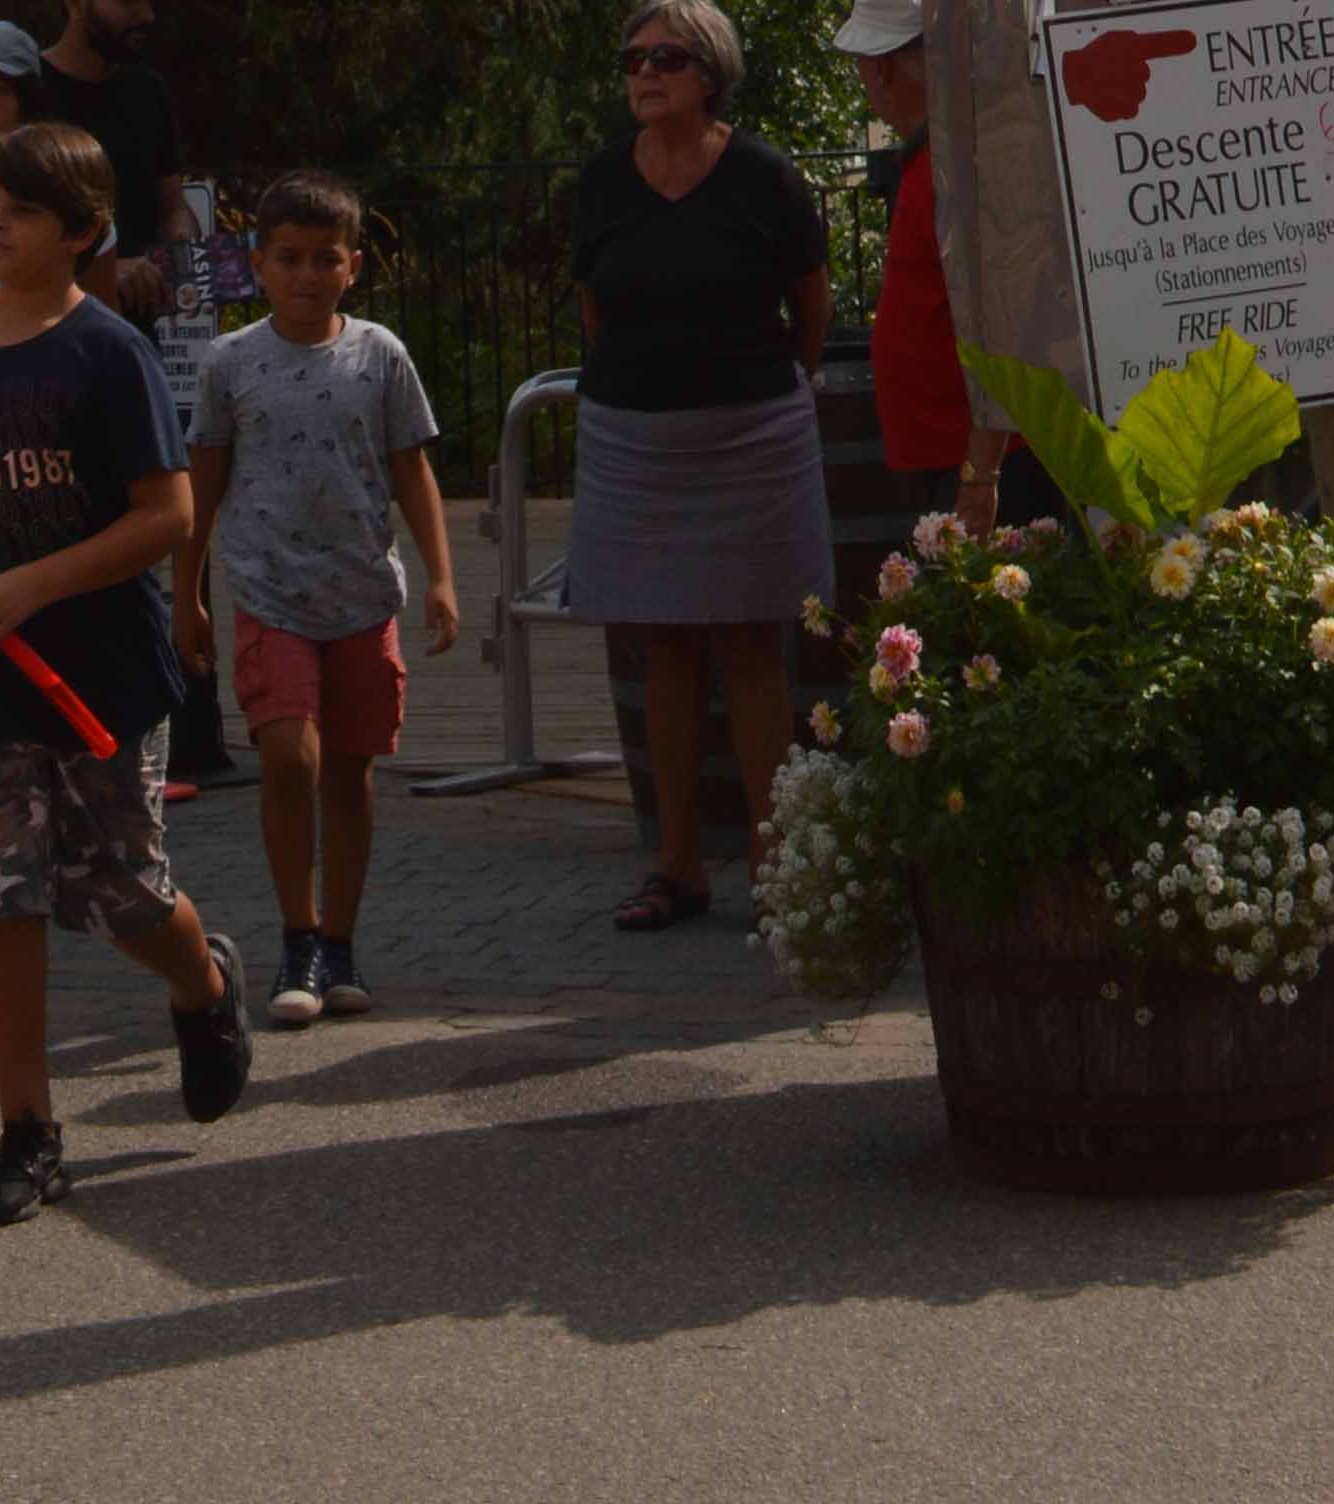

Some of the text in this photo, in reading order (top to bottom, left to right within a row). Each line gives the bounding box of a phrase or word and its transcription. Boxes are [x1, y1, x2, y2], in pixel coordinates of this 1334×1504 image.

[1115, 118, 1305, 174] Descente
[1128, 161, 1312, 228] GRATUITE
[1087, 237, 1154, 273] Jusqu'à
[1159, 231, 1177, 260] la
[1182, 229, 1230, 257] Place
[1236, 226, 1269, 248] des
[1155, 254, 1308, 295] (Stationnements)
[1243, 298, 1299, 333] RIDE
[1119, 359, 1140, 382] To
